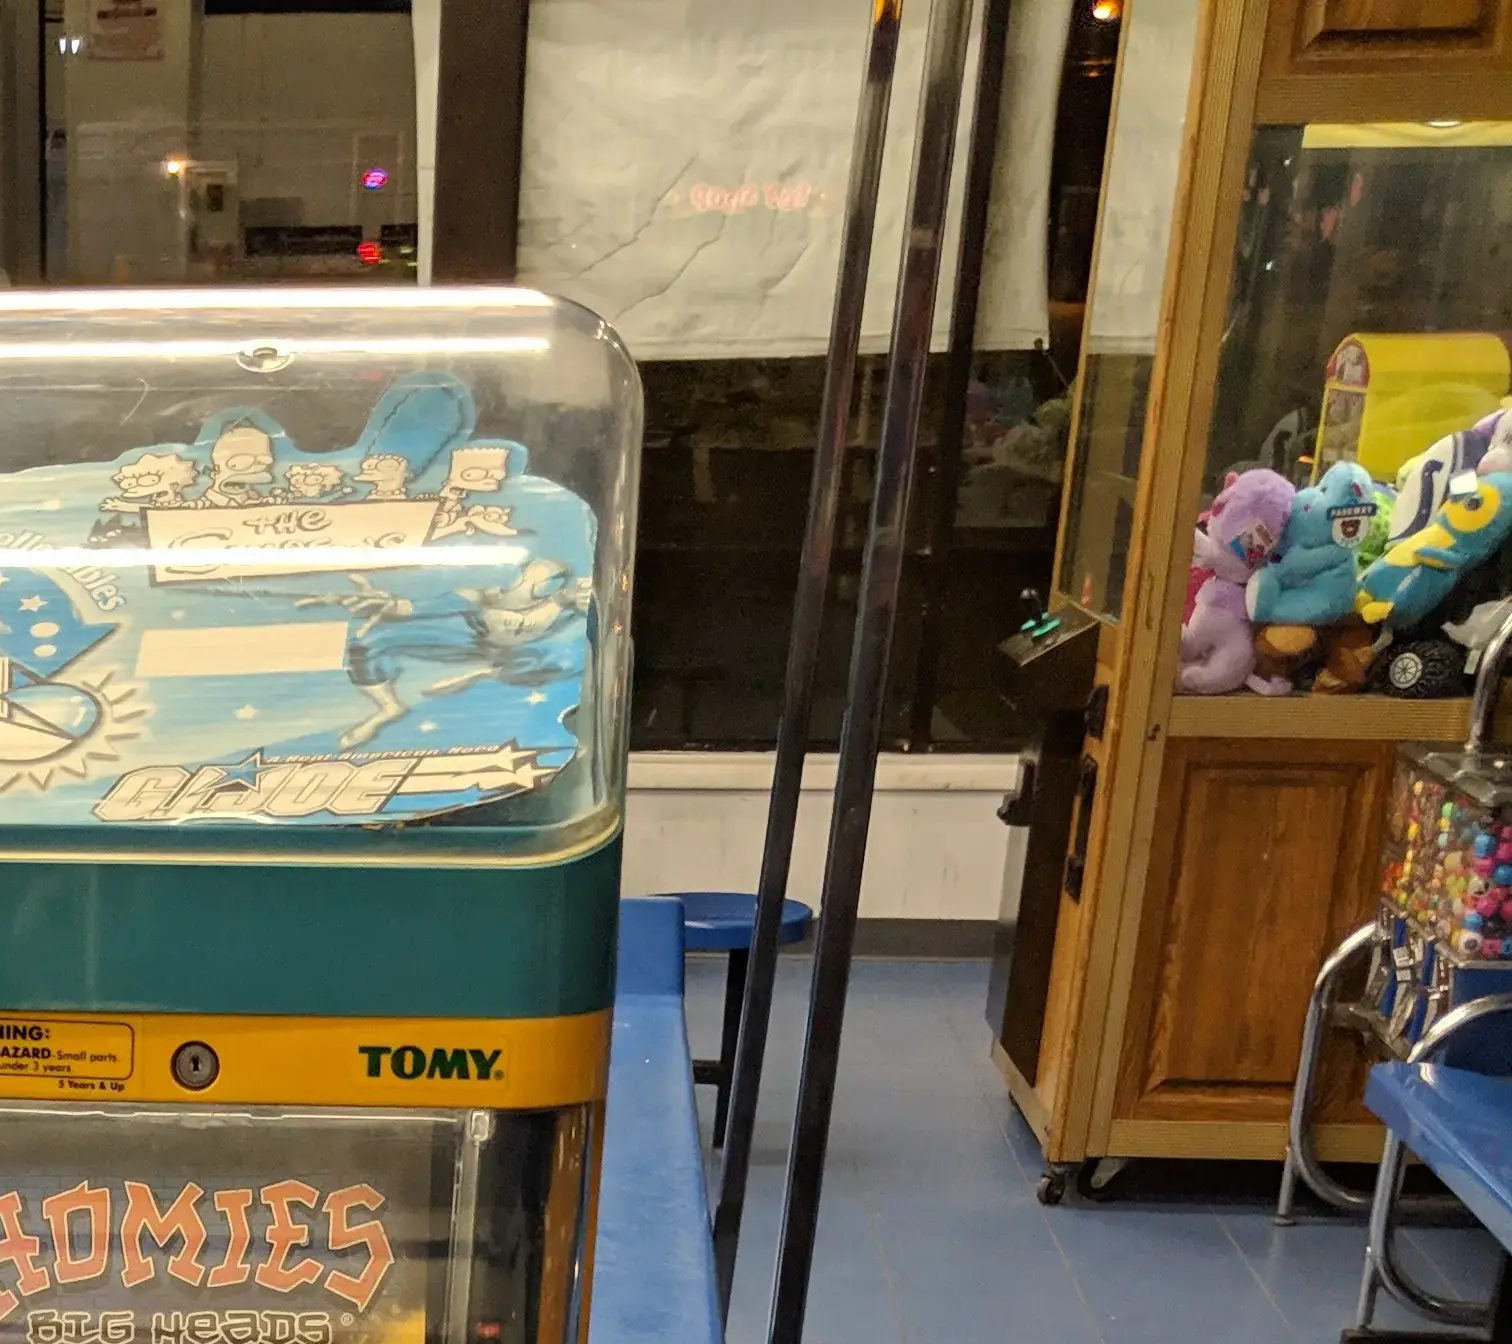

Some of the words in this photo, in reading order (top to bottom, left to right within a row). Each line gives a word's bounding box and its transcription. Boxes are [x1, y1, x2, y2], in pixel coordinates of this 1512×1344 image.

[243, 508, 333, 536] THE
[68, 1080, 95, 1090] Years
[99, 1081, 107, 1090] &
[111, 1082, 125, 1093] Up
